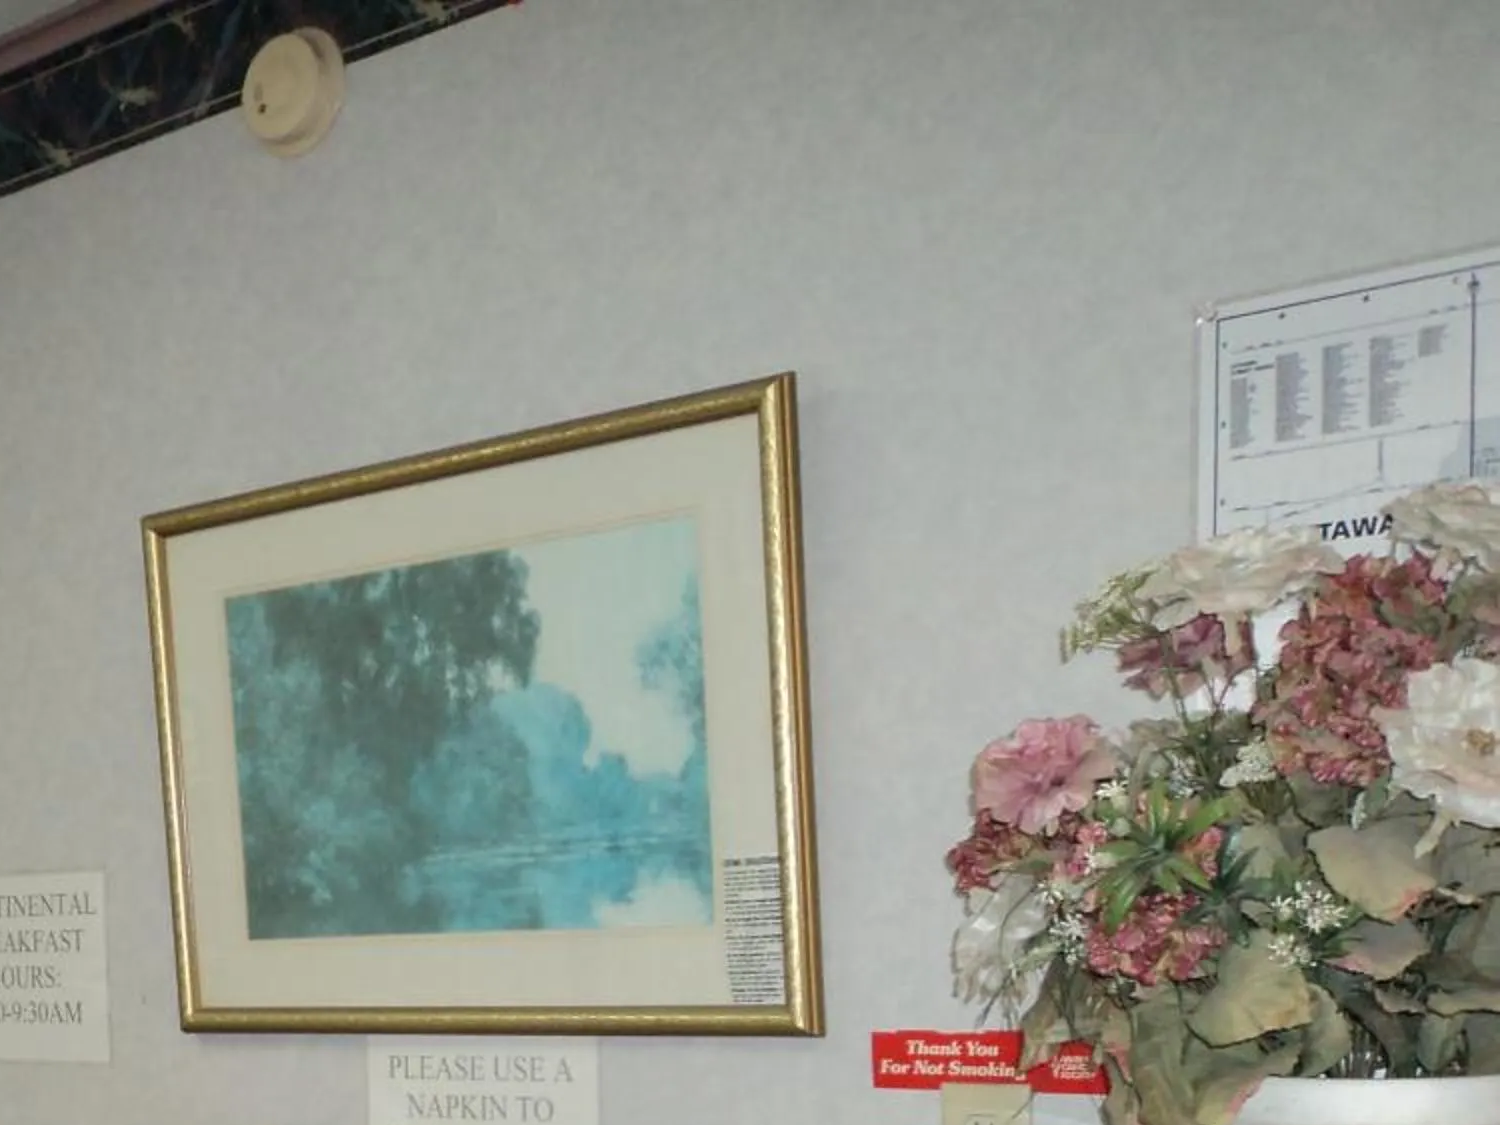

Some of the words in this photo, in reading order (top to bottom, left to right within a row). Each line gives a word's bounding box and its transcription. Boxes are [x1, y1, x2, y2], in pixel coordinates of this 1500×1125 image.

[905, 1039, 962, 1057] Thank
[966, 1039, 1000, 1057] You
[388, 1055, 485, 1082] PLEASE
[493, 1055, 546, 1082] USE
[553, 1057, 575, 1083] A
[880, 1060, 910, 1075] For
[913, 1060, 945, 1076] Not
[405, 1093, 508, 1121] NAPKIN
[515, 1096, 555, 1123] TO
